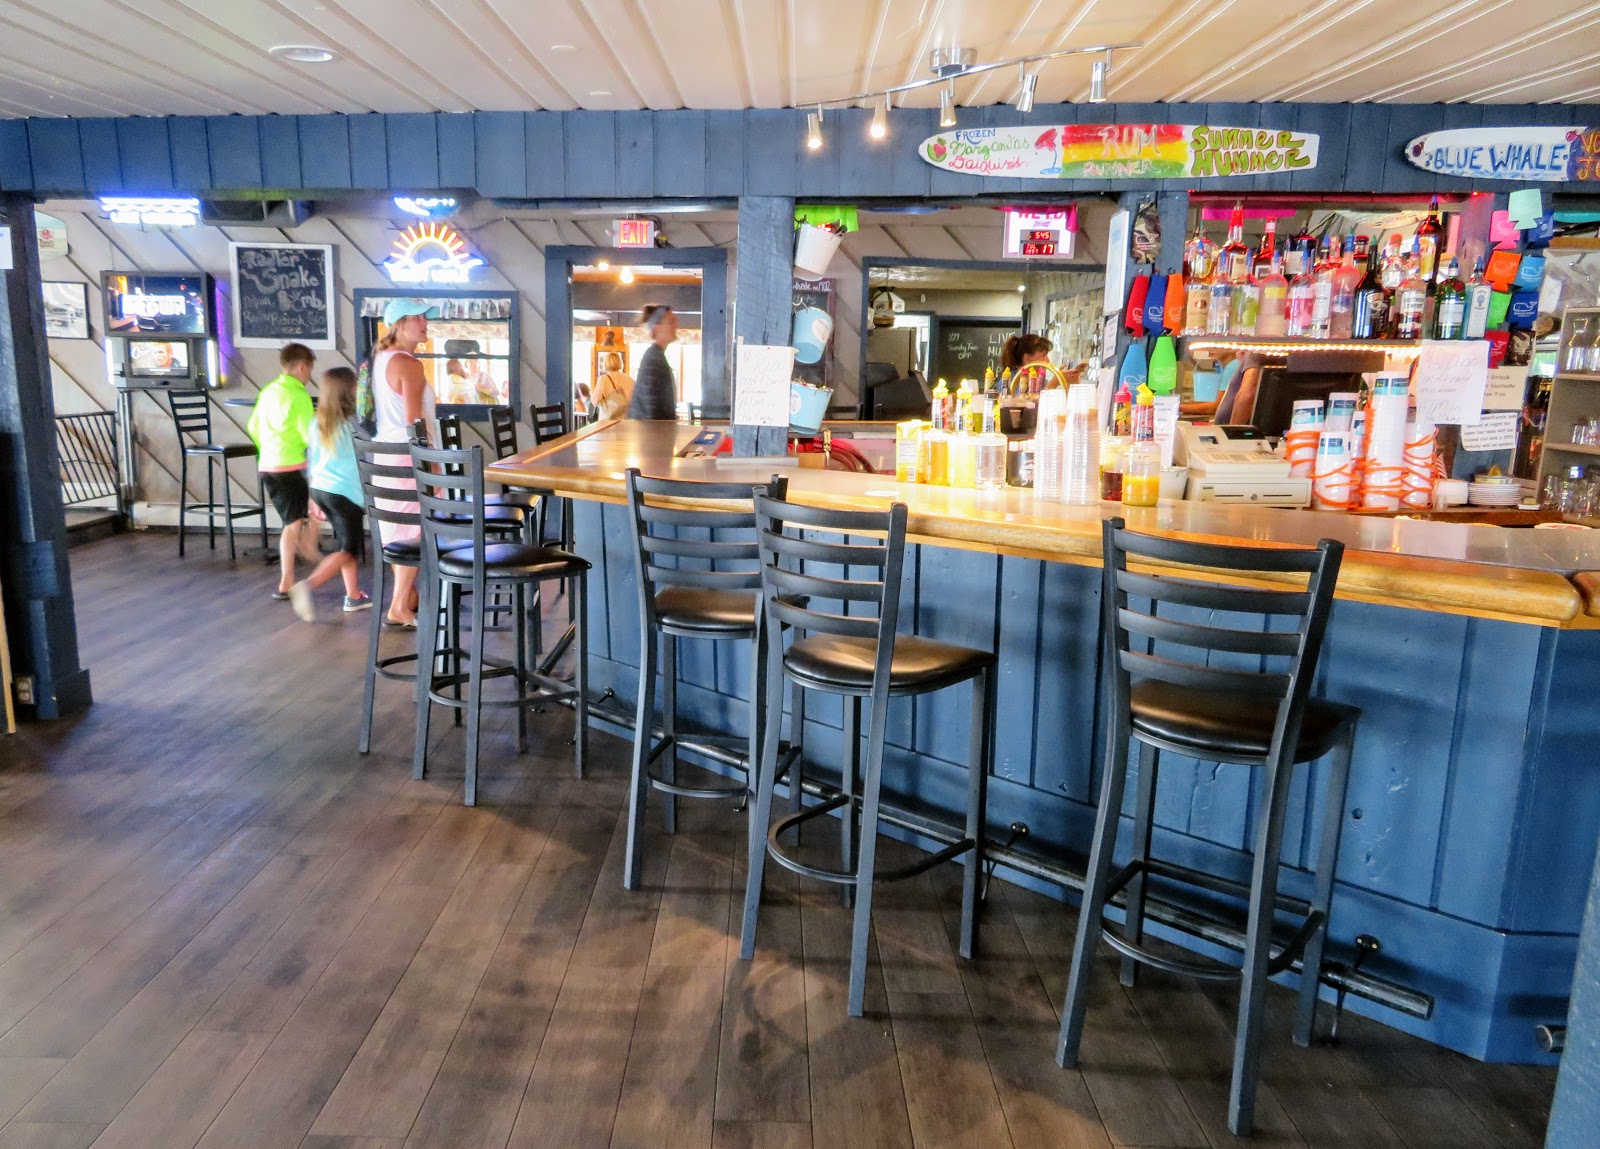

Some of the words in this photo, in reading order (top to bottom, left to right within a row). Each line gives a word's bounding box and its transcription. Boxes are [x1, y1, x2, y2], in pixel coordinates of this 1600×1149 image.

[955, 128, 996, 145] FROZEN
[1083, 159, 1153, 177] RUNNER
[1434, 147, 1484, 170] BLUE
[1488, 144, 1566, 172] WHALE
[619, 220, 650, 245] EXIT
[240, 265, 320, 295] Snake
